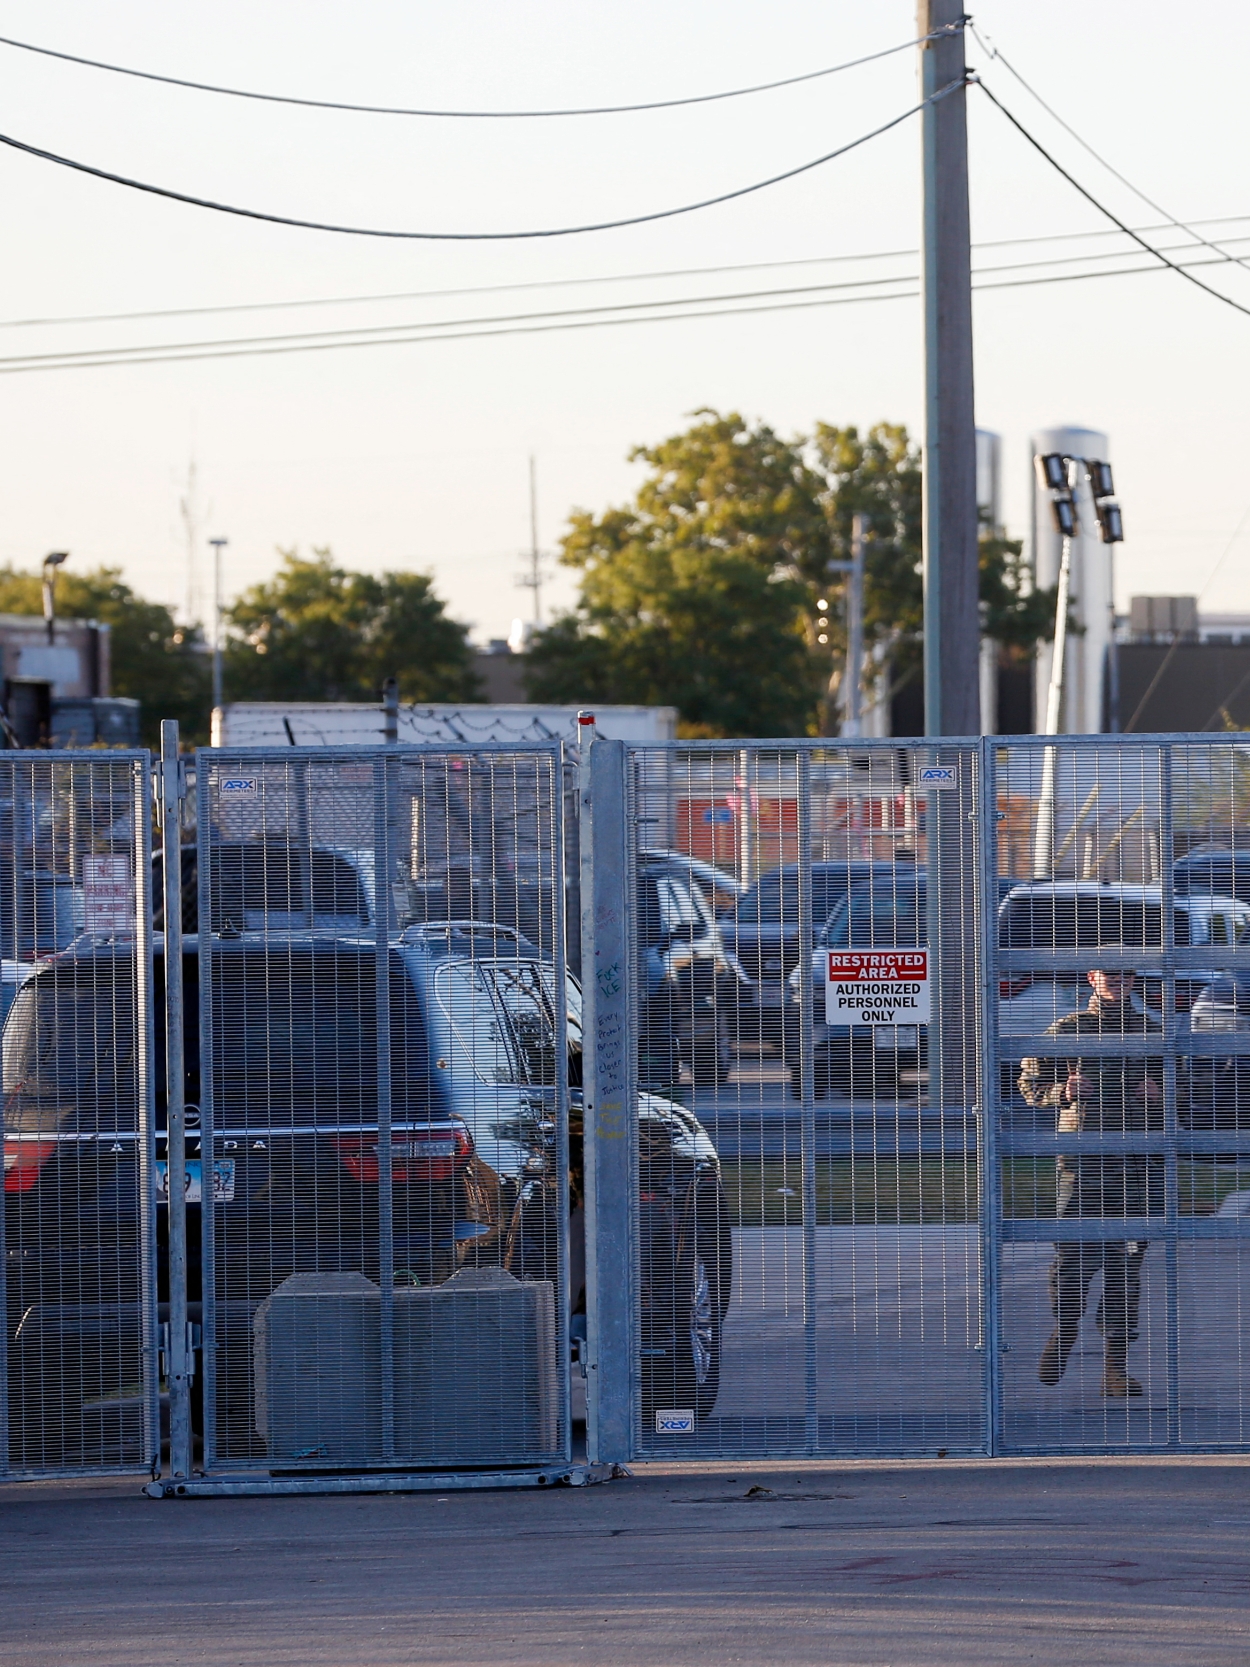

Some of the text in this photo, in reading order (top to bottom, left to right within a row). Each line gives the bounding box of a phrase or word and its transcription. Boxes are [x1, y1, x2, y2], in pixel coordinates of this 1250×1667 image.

[922, 770, 953, 778] ARX
[223, 780, 254, 789] ARX
[831, 955, 924, 967] RESTRICTED
[858, 967, 899, 979] AREA
[601, 979, 620, 998] ICE
[836, 984, 921, 995] AUTHORIZED
[838, 997, 918, 1008] PERSONNEL
[861, 1010, 895, 1022] ONLY
[660, 1420, 690, 1429] ARX
